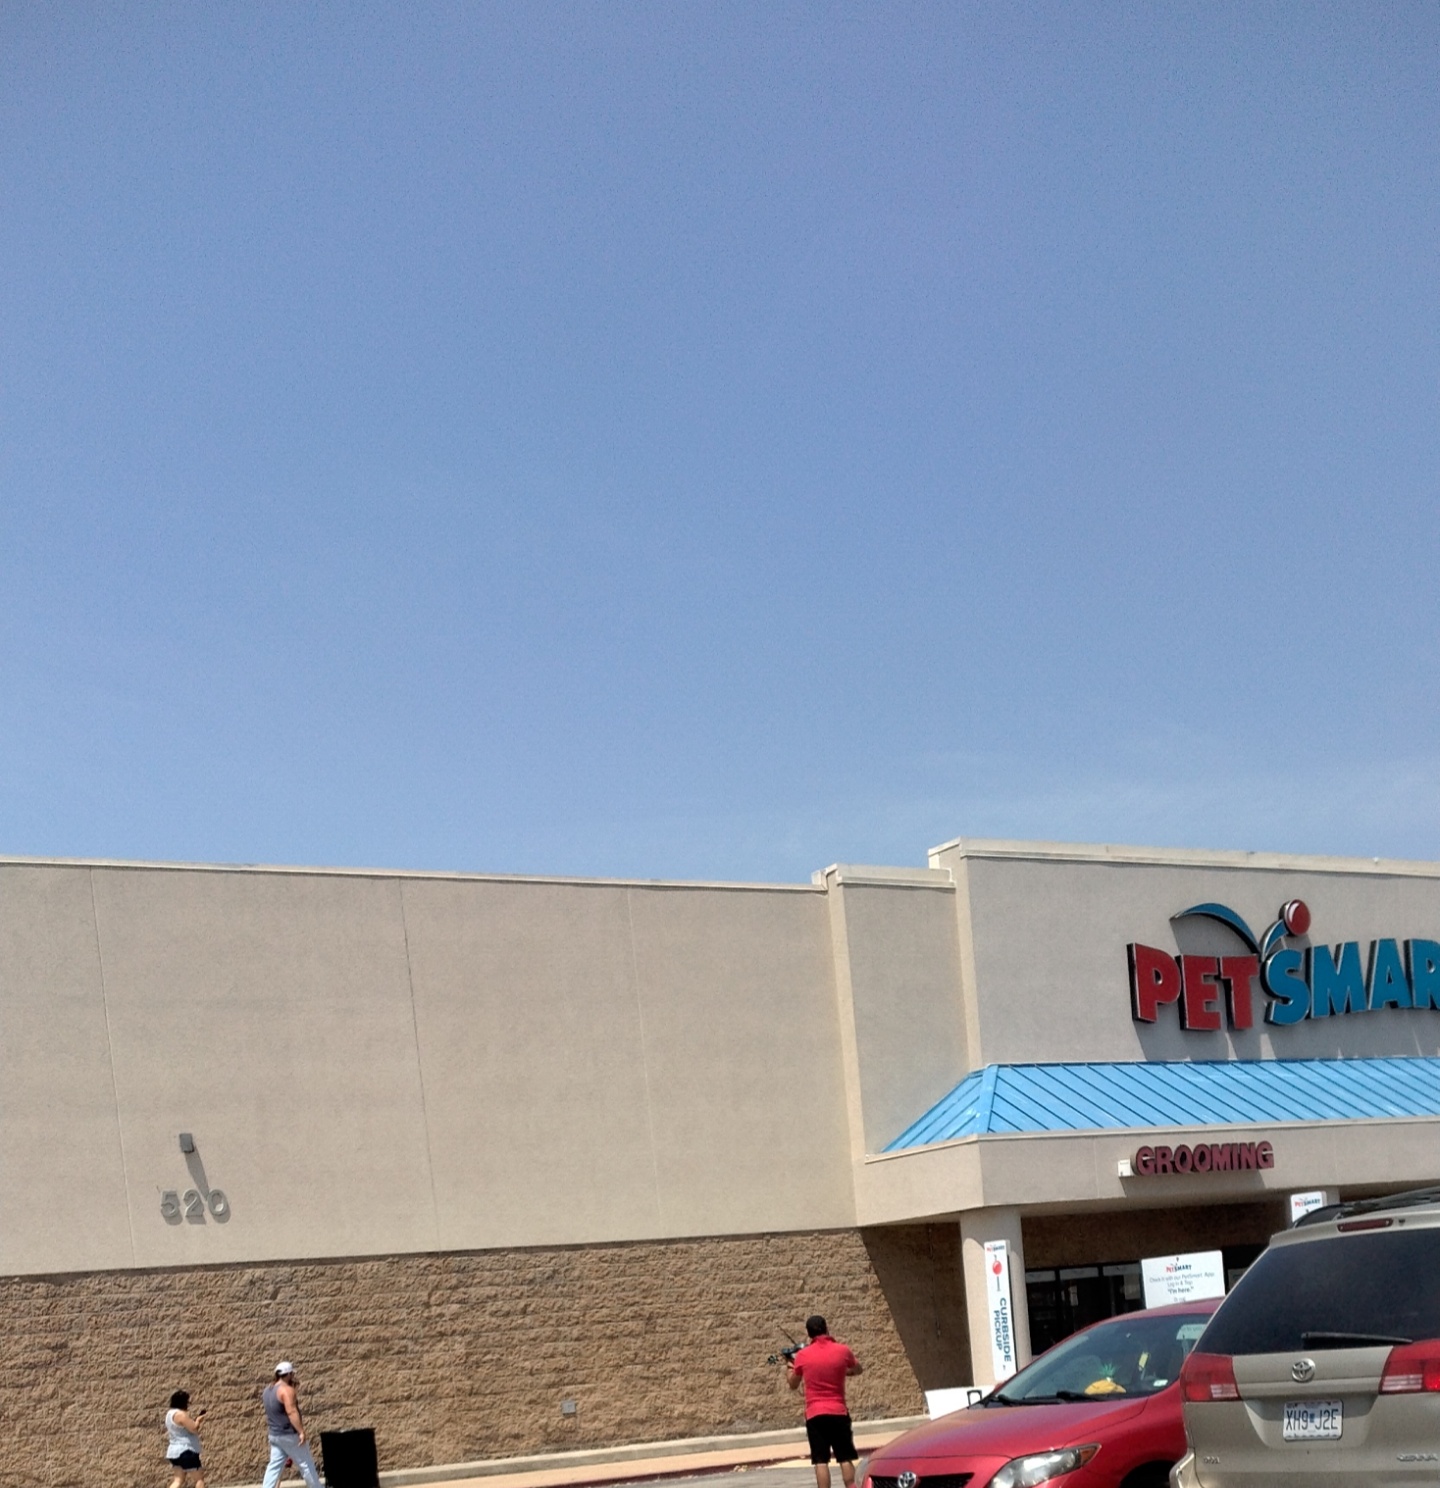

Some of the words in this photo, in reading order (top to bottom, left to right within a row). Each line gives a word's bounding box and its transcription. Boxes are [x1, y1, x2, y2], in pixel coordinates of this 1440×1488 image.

[1135, 1141, 1274, 1176] GROOMING
[160, 1188, 227, 1218] 520
[1165, 1264, 1192, 1273] PETSMART
[993, 1310, 1003, 1351] PICKUP
[1000, 1297, 1012, 1362] CURBSIDE
